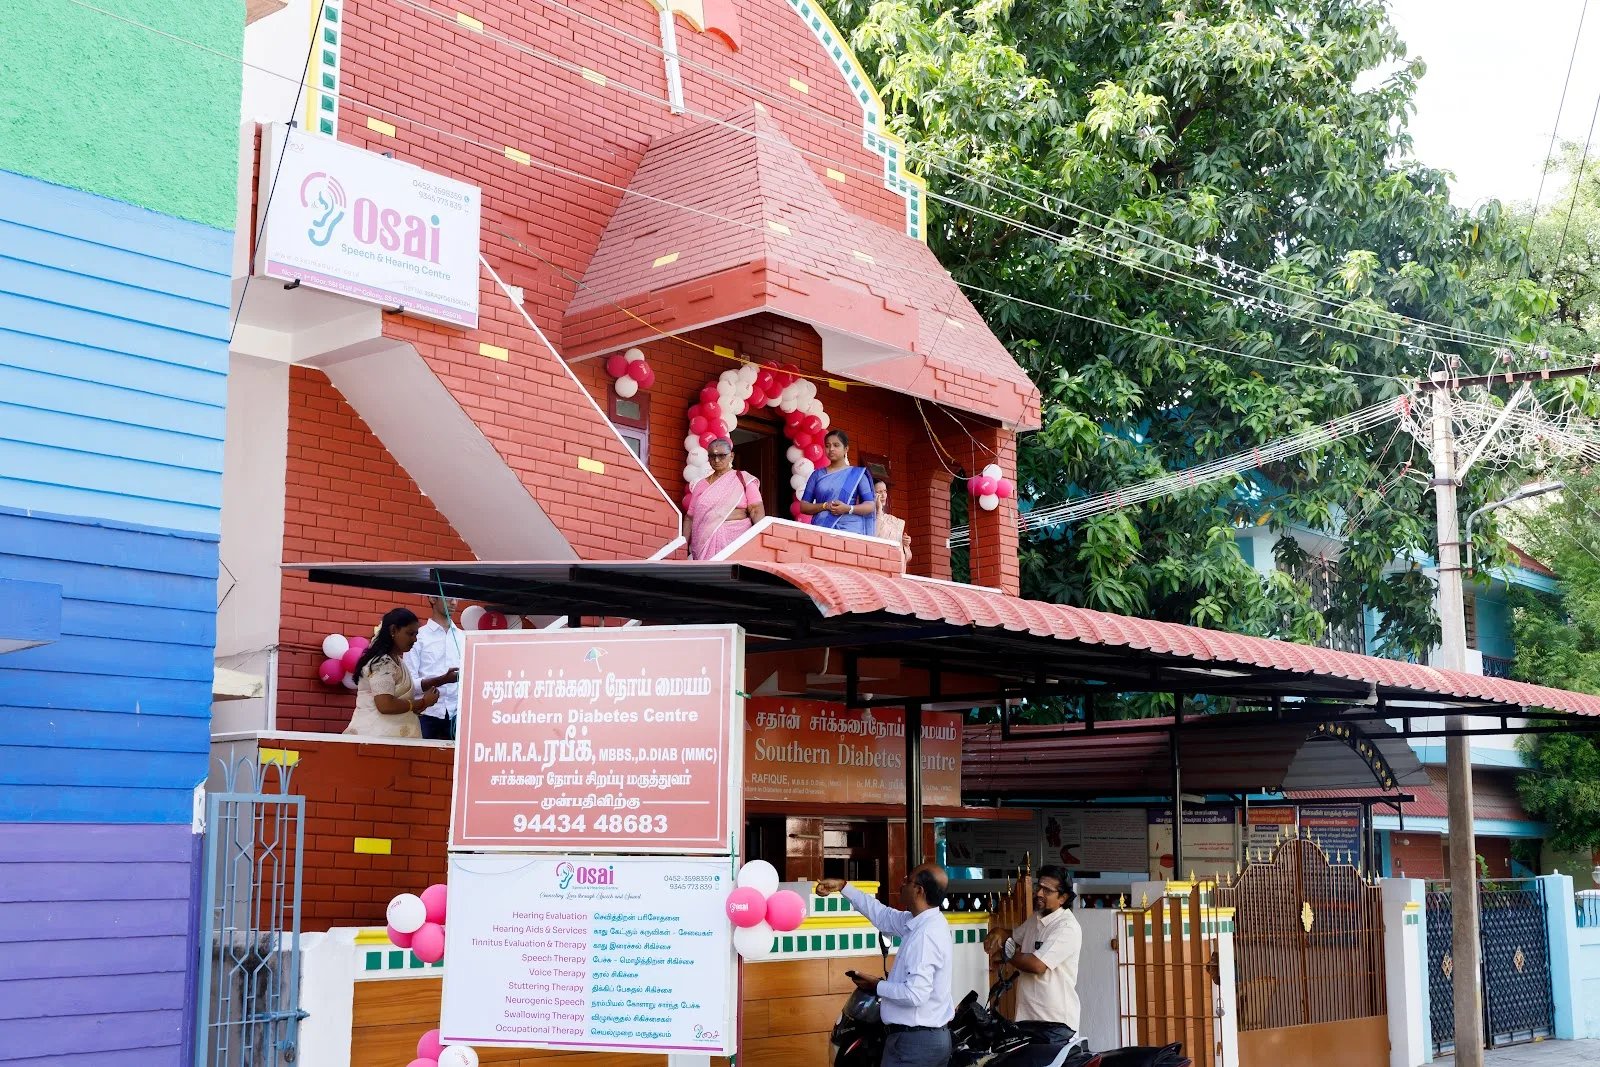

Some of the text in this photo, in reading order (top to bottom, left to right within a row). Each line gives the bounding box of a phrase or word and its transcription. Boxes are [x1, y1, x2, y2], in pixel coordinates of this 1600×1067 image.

[341, 243, 451, 281] Speech & Hearing Centre
[482, 667, 712, 704] சதர்ன் சர்க்கரை நோய் மையம்
[492, 708, 698, 724] Southern Diabetes Centre
[756, 706, 800, 732] சதர்ன்
[681, 748, 718, 764] (MMC)
[754, 738, 956, 772] Southern Diabetes entre
[490, 768, 692, 789] சர்க்கரை நோய் சிறப்பு மருத்துவர்
[751, 773, 790, 786] RAFIQUE,
[540, 792, 640, 810] முன்பதிவிற்கு
[513, 814, 668, 834] 94434 48683
[512, 911, 588, 921] Hearing Evaluation
[492, 925, 524, 934] Hearing
[525, 925, 543, 934] Aids
[552, 926, 587, 934] Services
[472, 939, 502, 947] Tinnitus
[504, 939, 545, 948] Evaluation
[554, 940, 587, 950] Therapy
[522, 954, 586, 964] Speech Therapy
[529, 968, 586, 979] Voice Therapy
[508, 982, 584, 993] Stuttering Therapy
[505, 996, 585, 1007] Neurogenic Speech
[504, 1010, 585, 1021] Swallowing Therapy
[496, 1024, 584, 1036] Occupational Therapy
